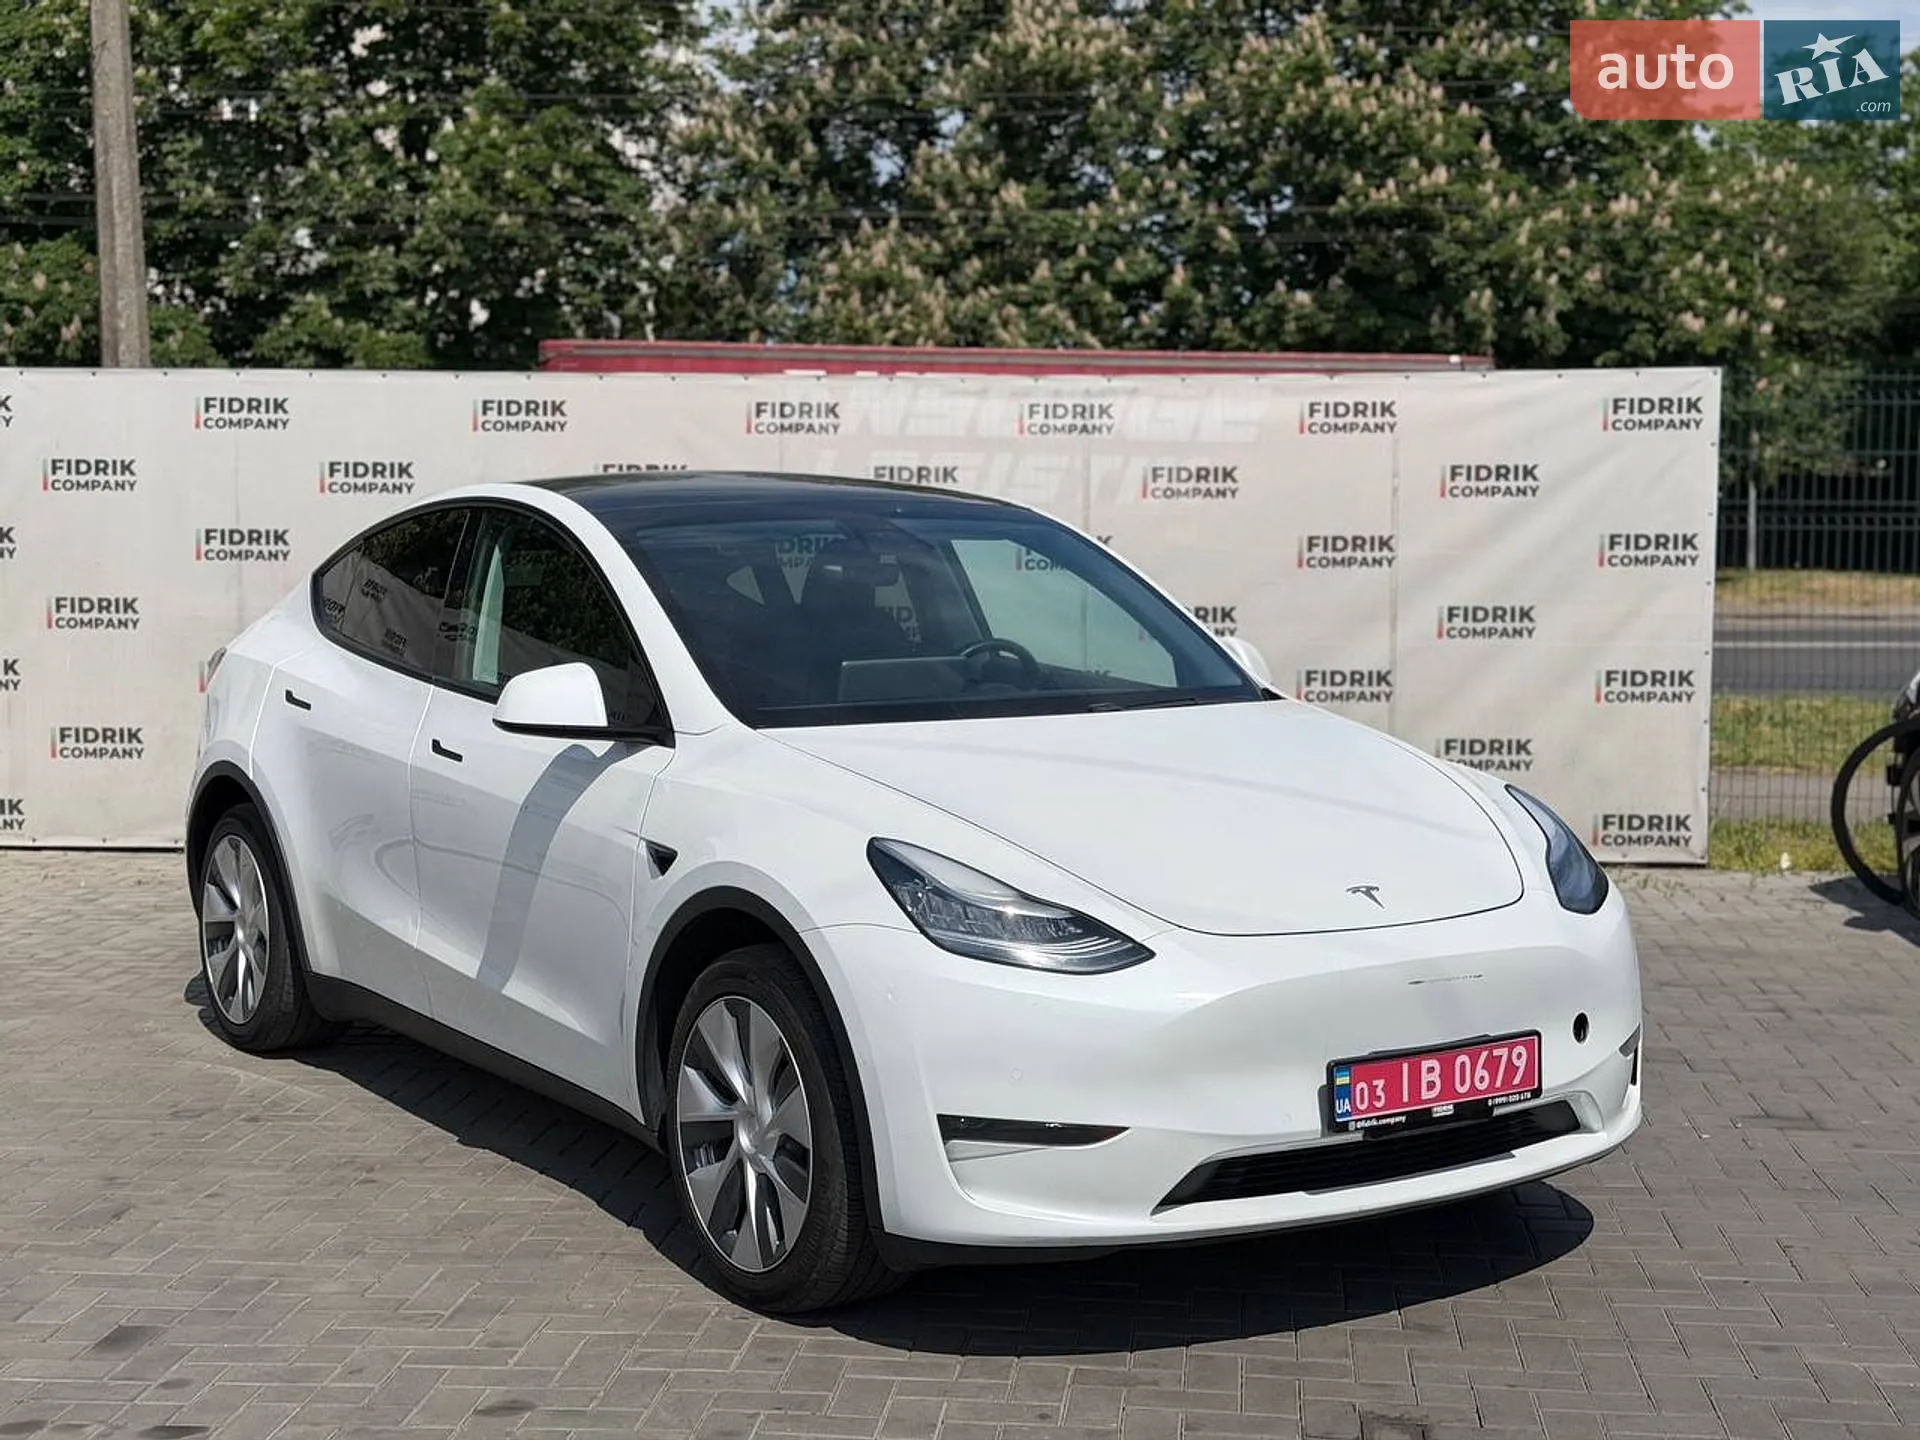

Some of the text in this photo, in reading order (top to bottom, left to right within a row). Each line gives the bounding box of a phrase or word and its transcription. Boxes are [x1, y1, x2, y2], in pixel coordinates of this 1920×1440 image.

[203, 396, 289, 415] FIDRIK
[481, 399, 567, 418] FIDRIK
[754, 401, 840, 420] FIDRIK
[1028, 403, 1113, 420] FIDRIK
[1308, 401, 1397, 419] FIDRIK
[1612, 396, 1703, 416] FIDRIK
[202, 416, 290, 430] COMPANY
[480, 419, 568, 433] COMPANY
[754, 422, 840, 435] COMPANY
[1027, 423, 1113, 436] COMPANY
[1307, 421, 1397, 435] COMPANY
[1610, 417, 1703, 432] COMPANY
[50, 458, 137, 477] FIDRIK
[328, 461, 415, 480] FIDRIK
[874, 465, 958, 484] FIDRIK
[1151, 465, 1238, 484] FIDRIK
[1449, 463, 1539, 483] FIDRIK
[50, 478, 137, 492] COMPANY
[327, 481, 415, 495] COMPANY
[1151, 486, 1239, 499] COMPANY
[1448, 484, 1540, 498] COMPANY
[204, 528, 290, 547] FIDRIK
[1306, 535, 1395, 554] FIDRIK
[1608, 532, 1699, 552] FIDRIK
[203, 548, 291, 562] COMPANY
[1305, 555, 1396, 569] COMPANY
[1607, 554, 1699, 568] COMPANY
[54, 596, 139, 615] FIDRIK
[54, 616, 140, 630] COMPANY
[1447, 605, 1535, 624] FIDRIK
[1445, 626, 1536, 640] COMPANY
[1305, 669, 1394, 688] FIDRIK
[1605, 669, 1695, 688] FIDRIK
[1303, 690, 1393, 703] COMPANY
[1603, 690, 1695, 704] COMPANY
[59, 726, 144, 745] FIDRIK
[58, 746, 145, 760] COMPANY
[1444, 738, 1532, 757] FIDRIK
[1447, 758, 1533, 772] MPANY
[1601, 813, 1691, 833] FIDRIK
[1600, 833, 1692, 848] COMPANY
[1354, 1078, 1386, 1110] 03
[1453, 1045, 1528, 1093] 0679
[1335, 1098, 1351, 1114] UA
